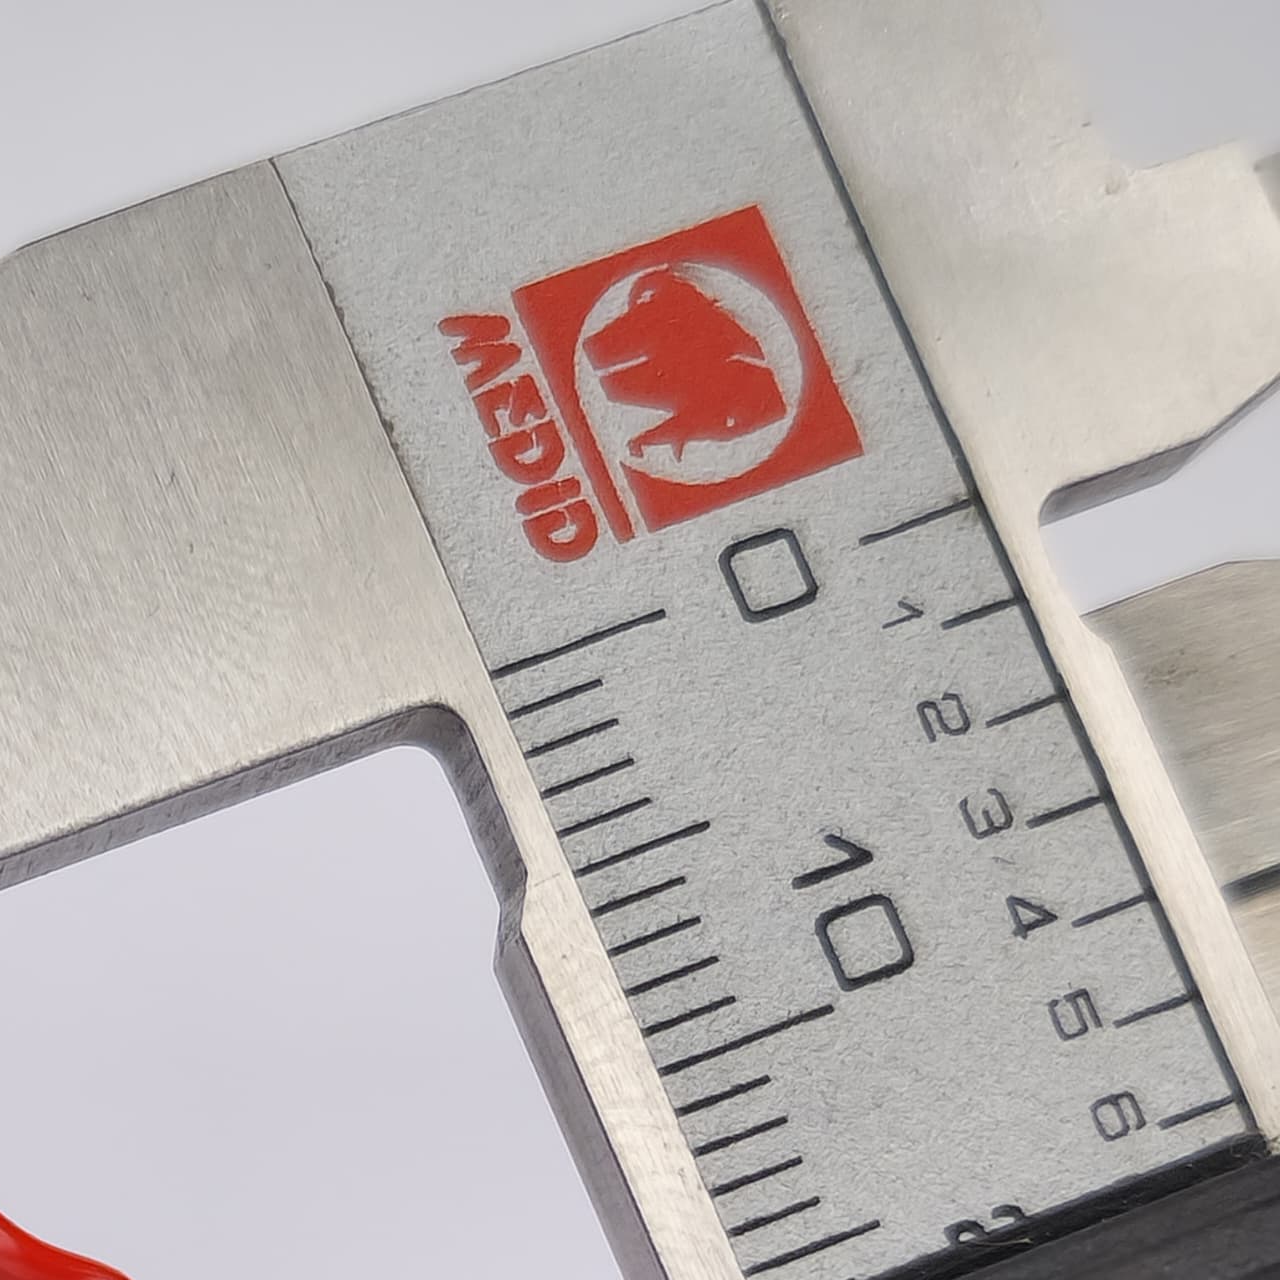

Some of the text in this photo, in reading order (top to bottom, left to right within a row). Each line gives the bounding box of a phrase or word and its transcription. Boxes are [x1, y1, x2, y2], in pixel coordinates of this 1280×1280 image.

[719, 527, 819, 624] 0
[881, 600, 925, 629] 1
[916, 692, 972, 743] 2
[959, 788, 1014, 840] 3
[791, 833, 916, 992] 10
[1006, 895, 1059, 940] 4
[1048, 988, 1104, 1041] 5
[1091, 1090, 1147, 1142] 6
